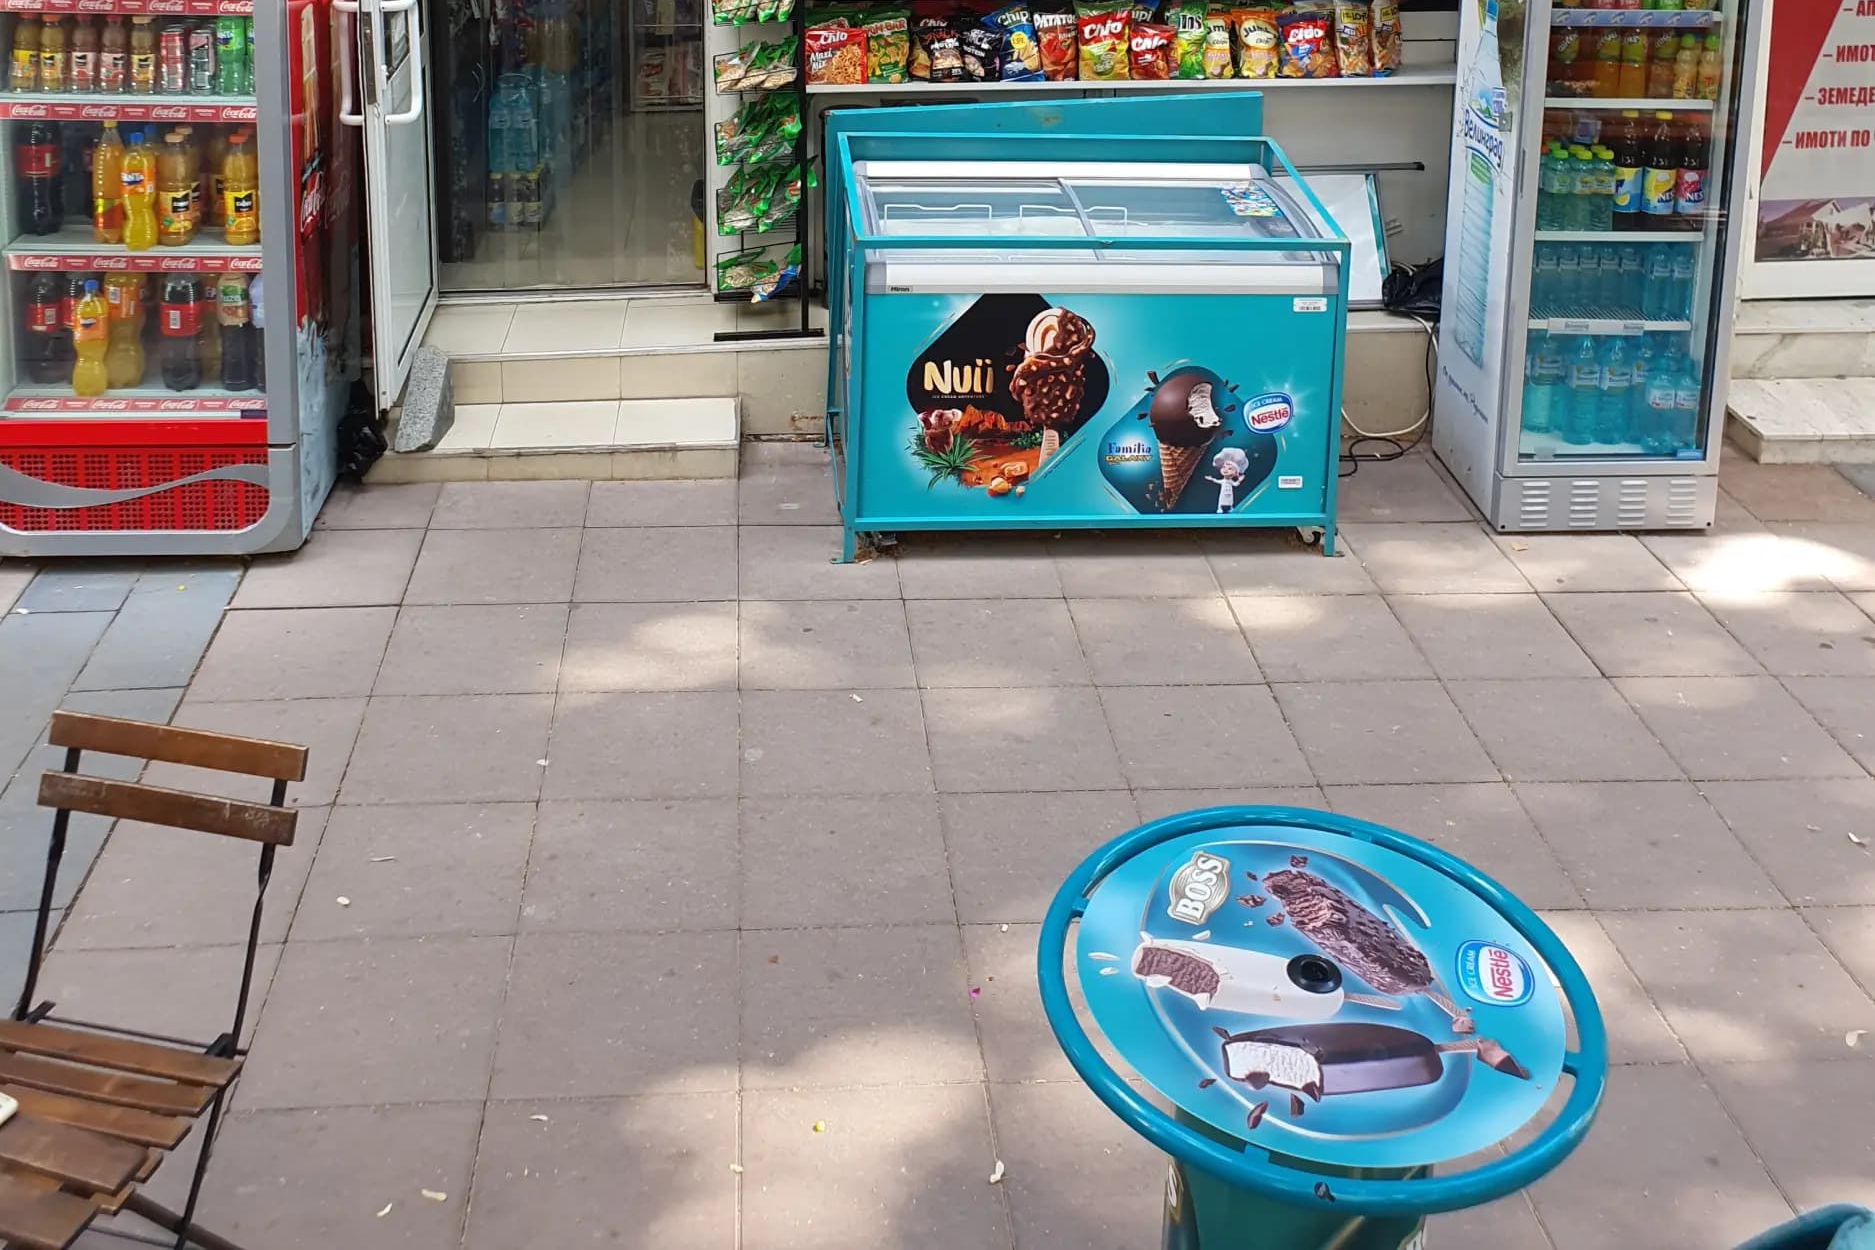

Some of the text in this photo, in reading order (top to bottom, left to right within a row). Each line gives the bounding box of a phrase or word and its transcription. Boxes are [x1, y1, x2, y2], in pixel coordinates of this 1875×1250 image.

[819, 32, 848, 45] Chio
[1083, 19, 1123, 39] Chio
[1464, 108, 1503, 168] Велинград
[1795, 129, 1871, 149] ИМОТИ ПО
[923, 358, 994, 394] Nuii
[1261, 396, 1283, 406] CREAM
[1250, 406, 1290, 426] Nestlé
[1108, 442, 1152, 454] Familia
[1175, 856, 1223, 920] BOSS
[1488, 949, 1514, 999] Nestlé
